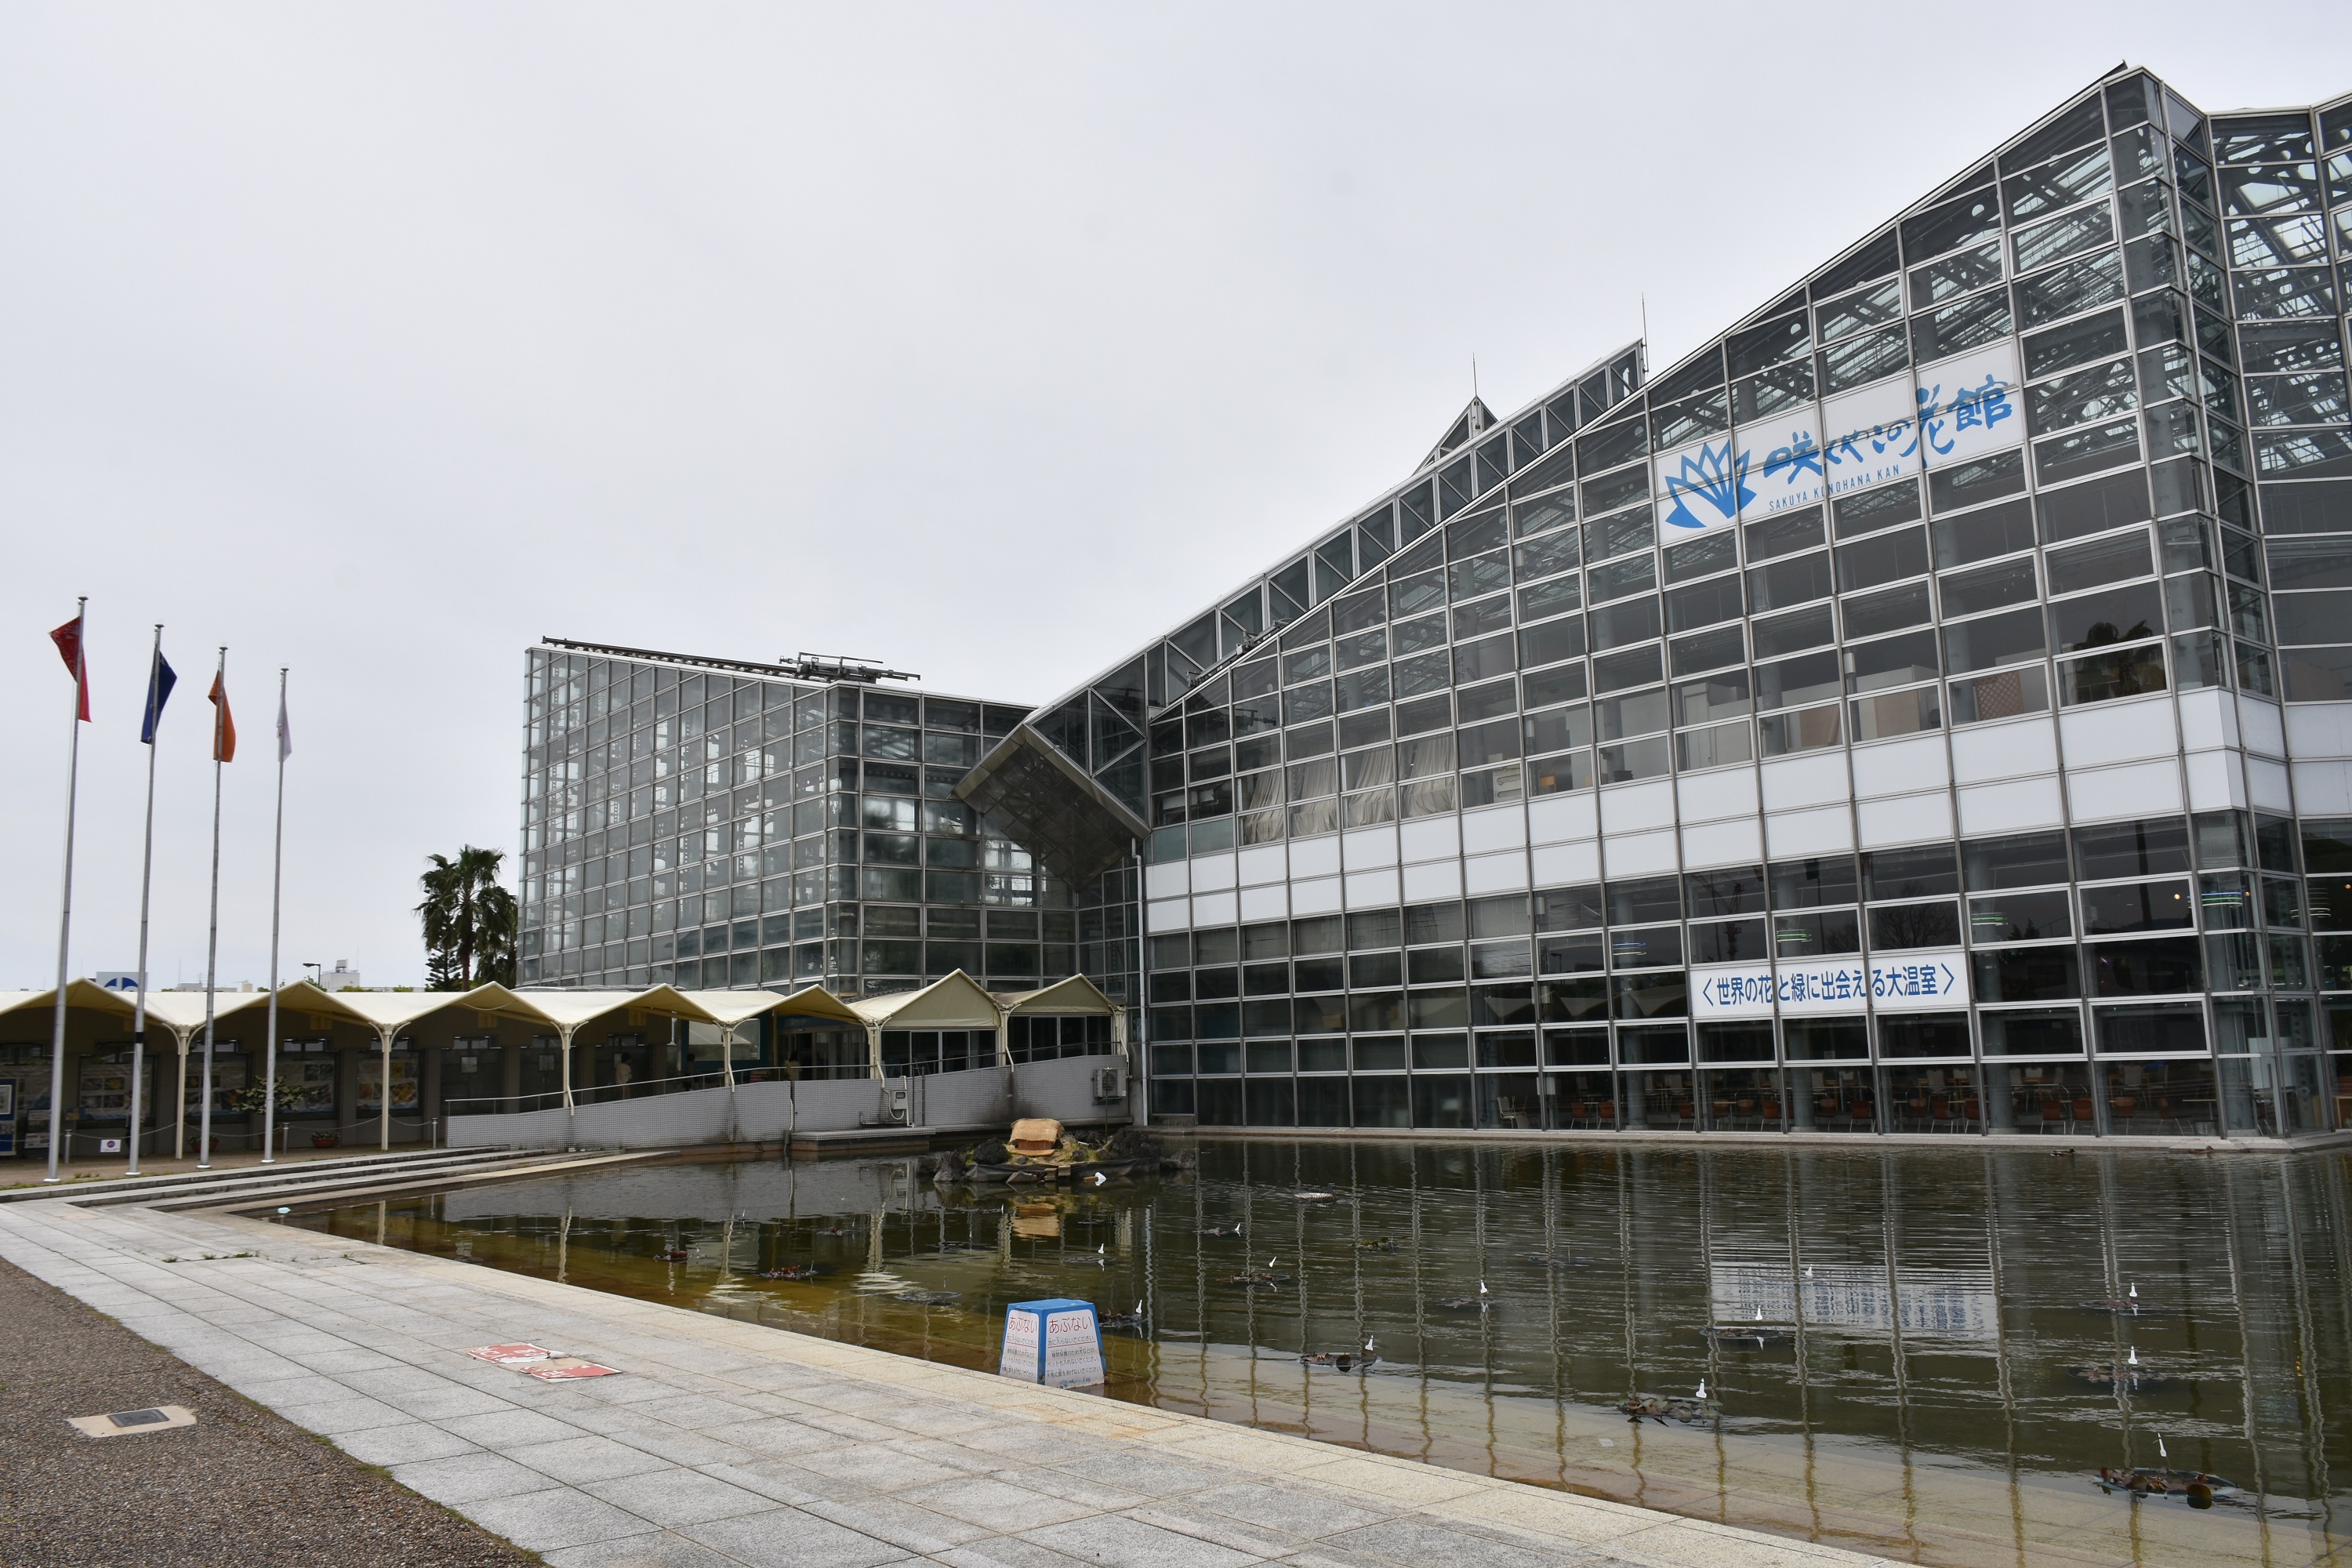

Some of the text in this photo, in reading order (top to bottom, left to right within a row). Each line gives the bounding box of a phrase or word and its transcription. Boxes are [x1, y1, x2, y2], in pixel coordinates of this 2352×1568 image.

[1763, 373, 2013, 485] 咲くやこの花館
[1769, 464, 1900, 511] SAKUYA KONOHANA KAN
[1008, 1316, 1037, 1334] あぶない
[1049, 1316, 1092, 1334] あぶない
